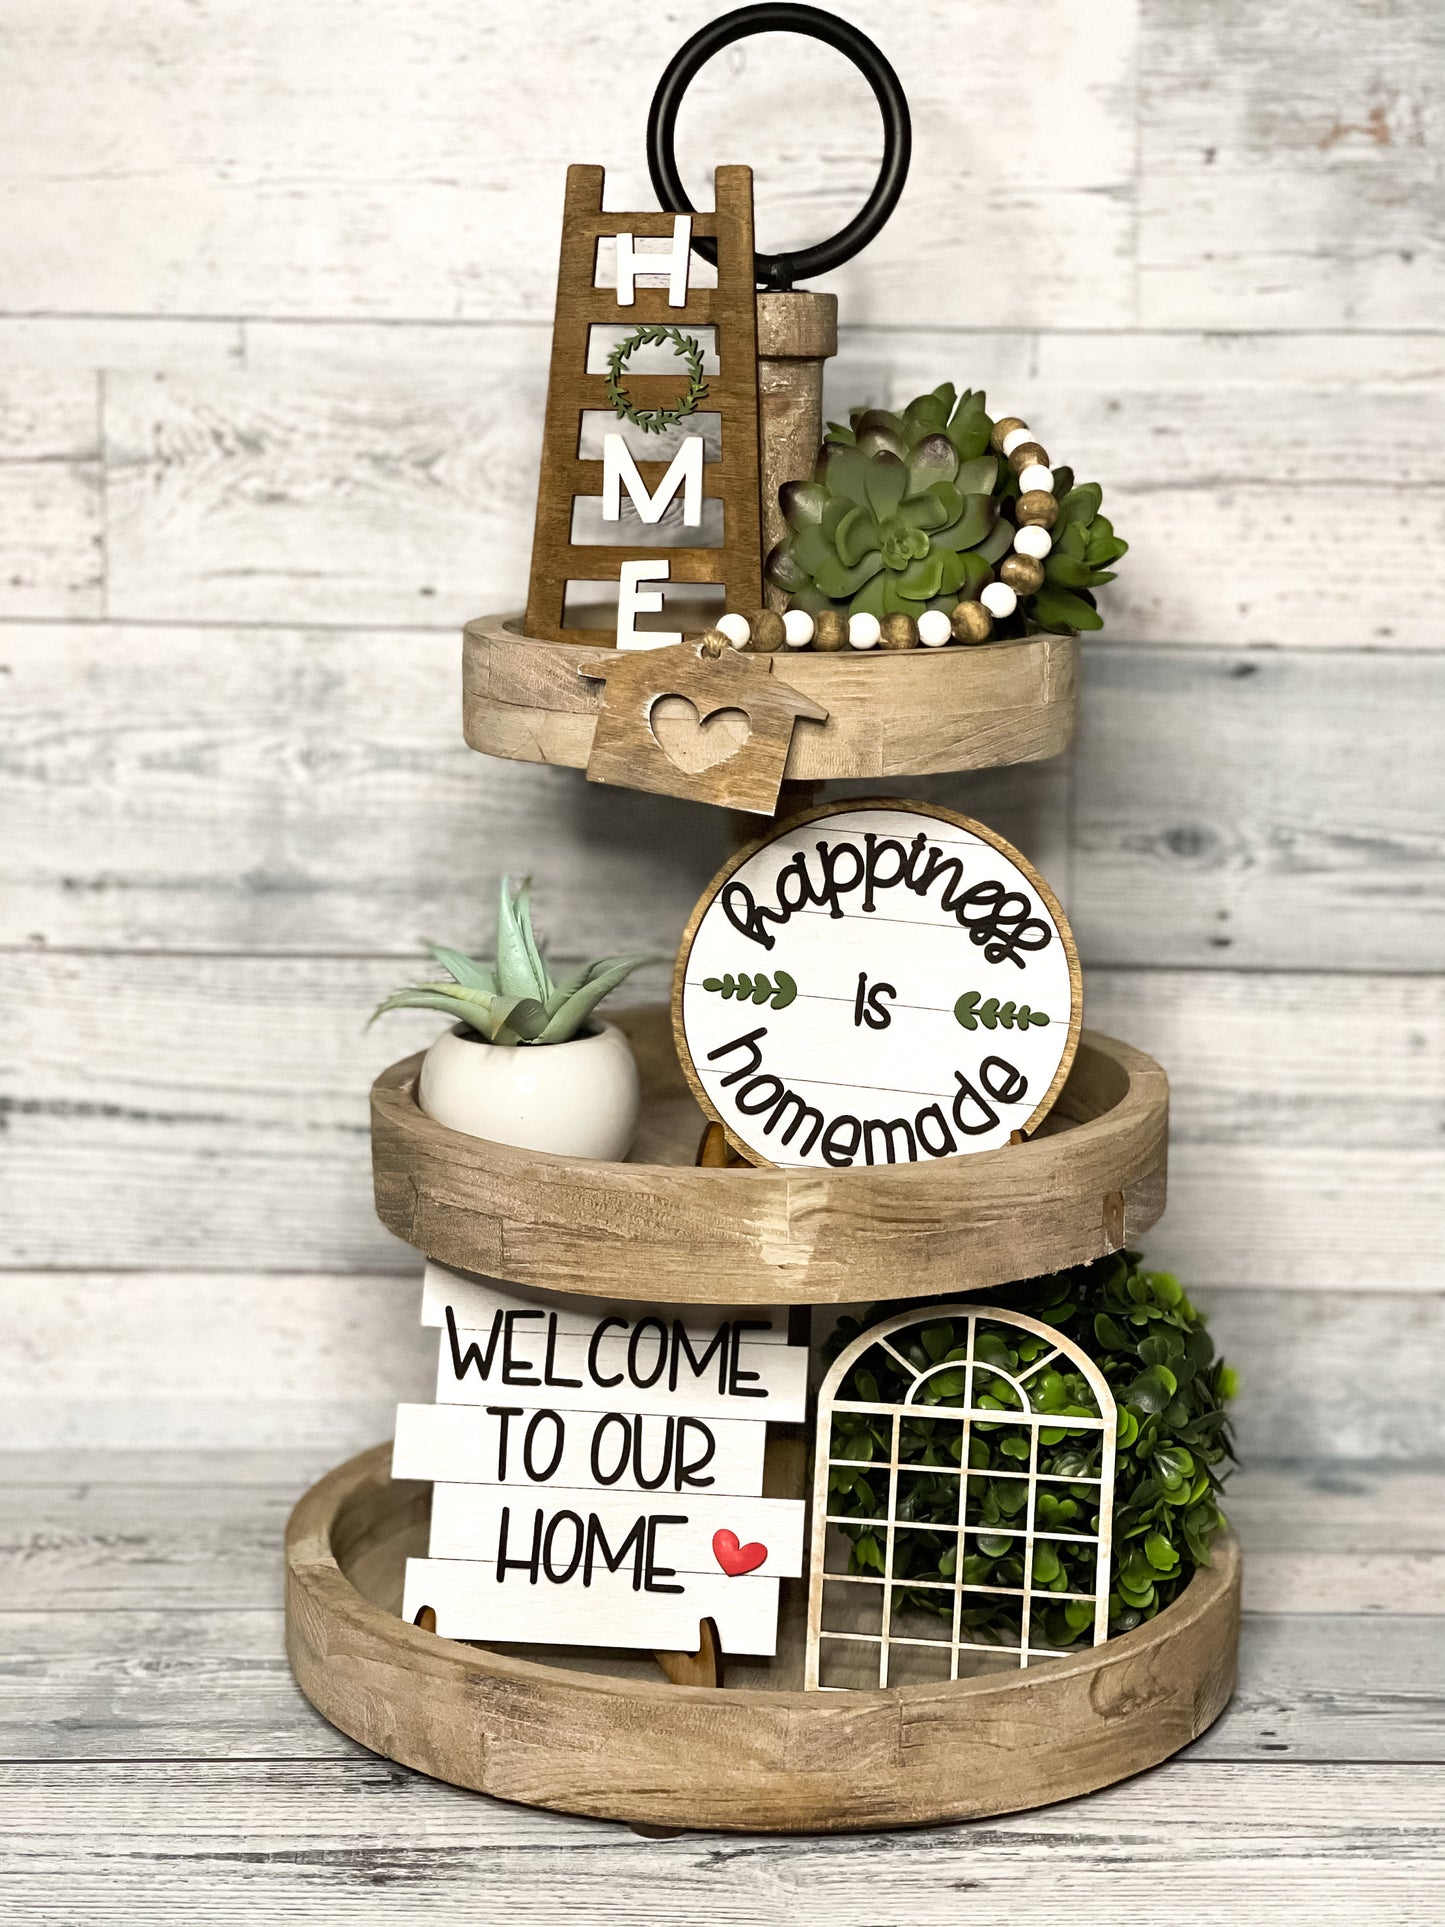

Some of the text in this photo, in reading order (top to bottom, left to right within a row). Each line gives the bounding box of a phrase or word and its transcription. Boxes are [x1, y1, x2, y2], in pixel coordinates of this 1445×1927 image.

[722, 832, 1052, 969] happiness
[707, 1027, 1028, 1167] homemade
[445, 1305, 773, 1398] WELCOME
[486, 1407, 716, 1492] TO OUR
[496, 1506, 689, 1594] HOME
